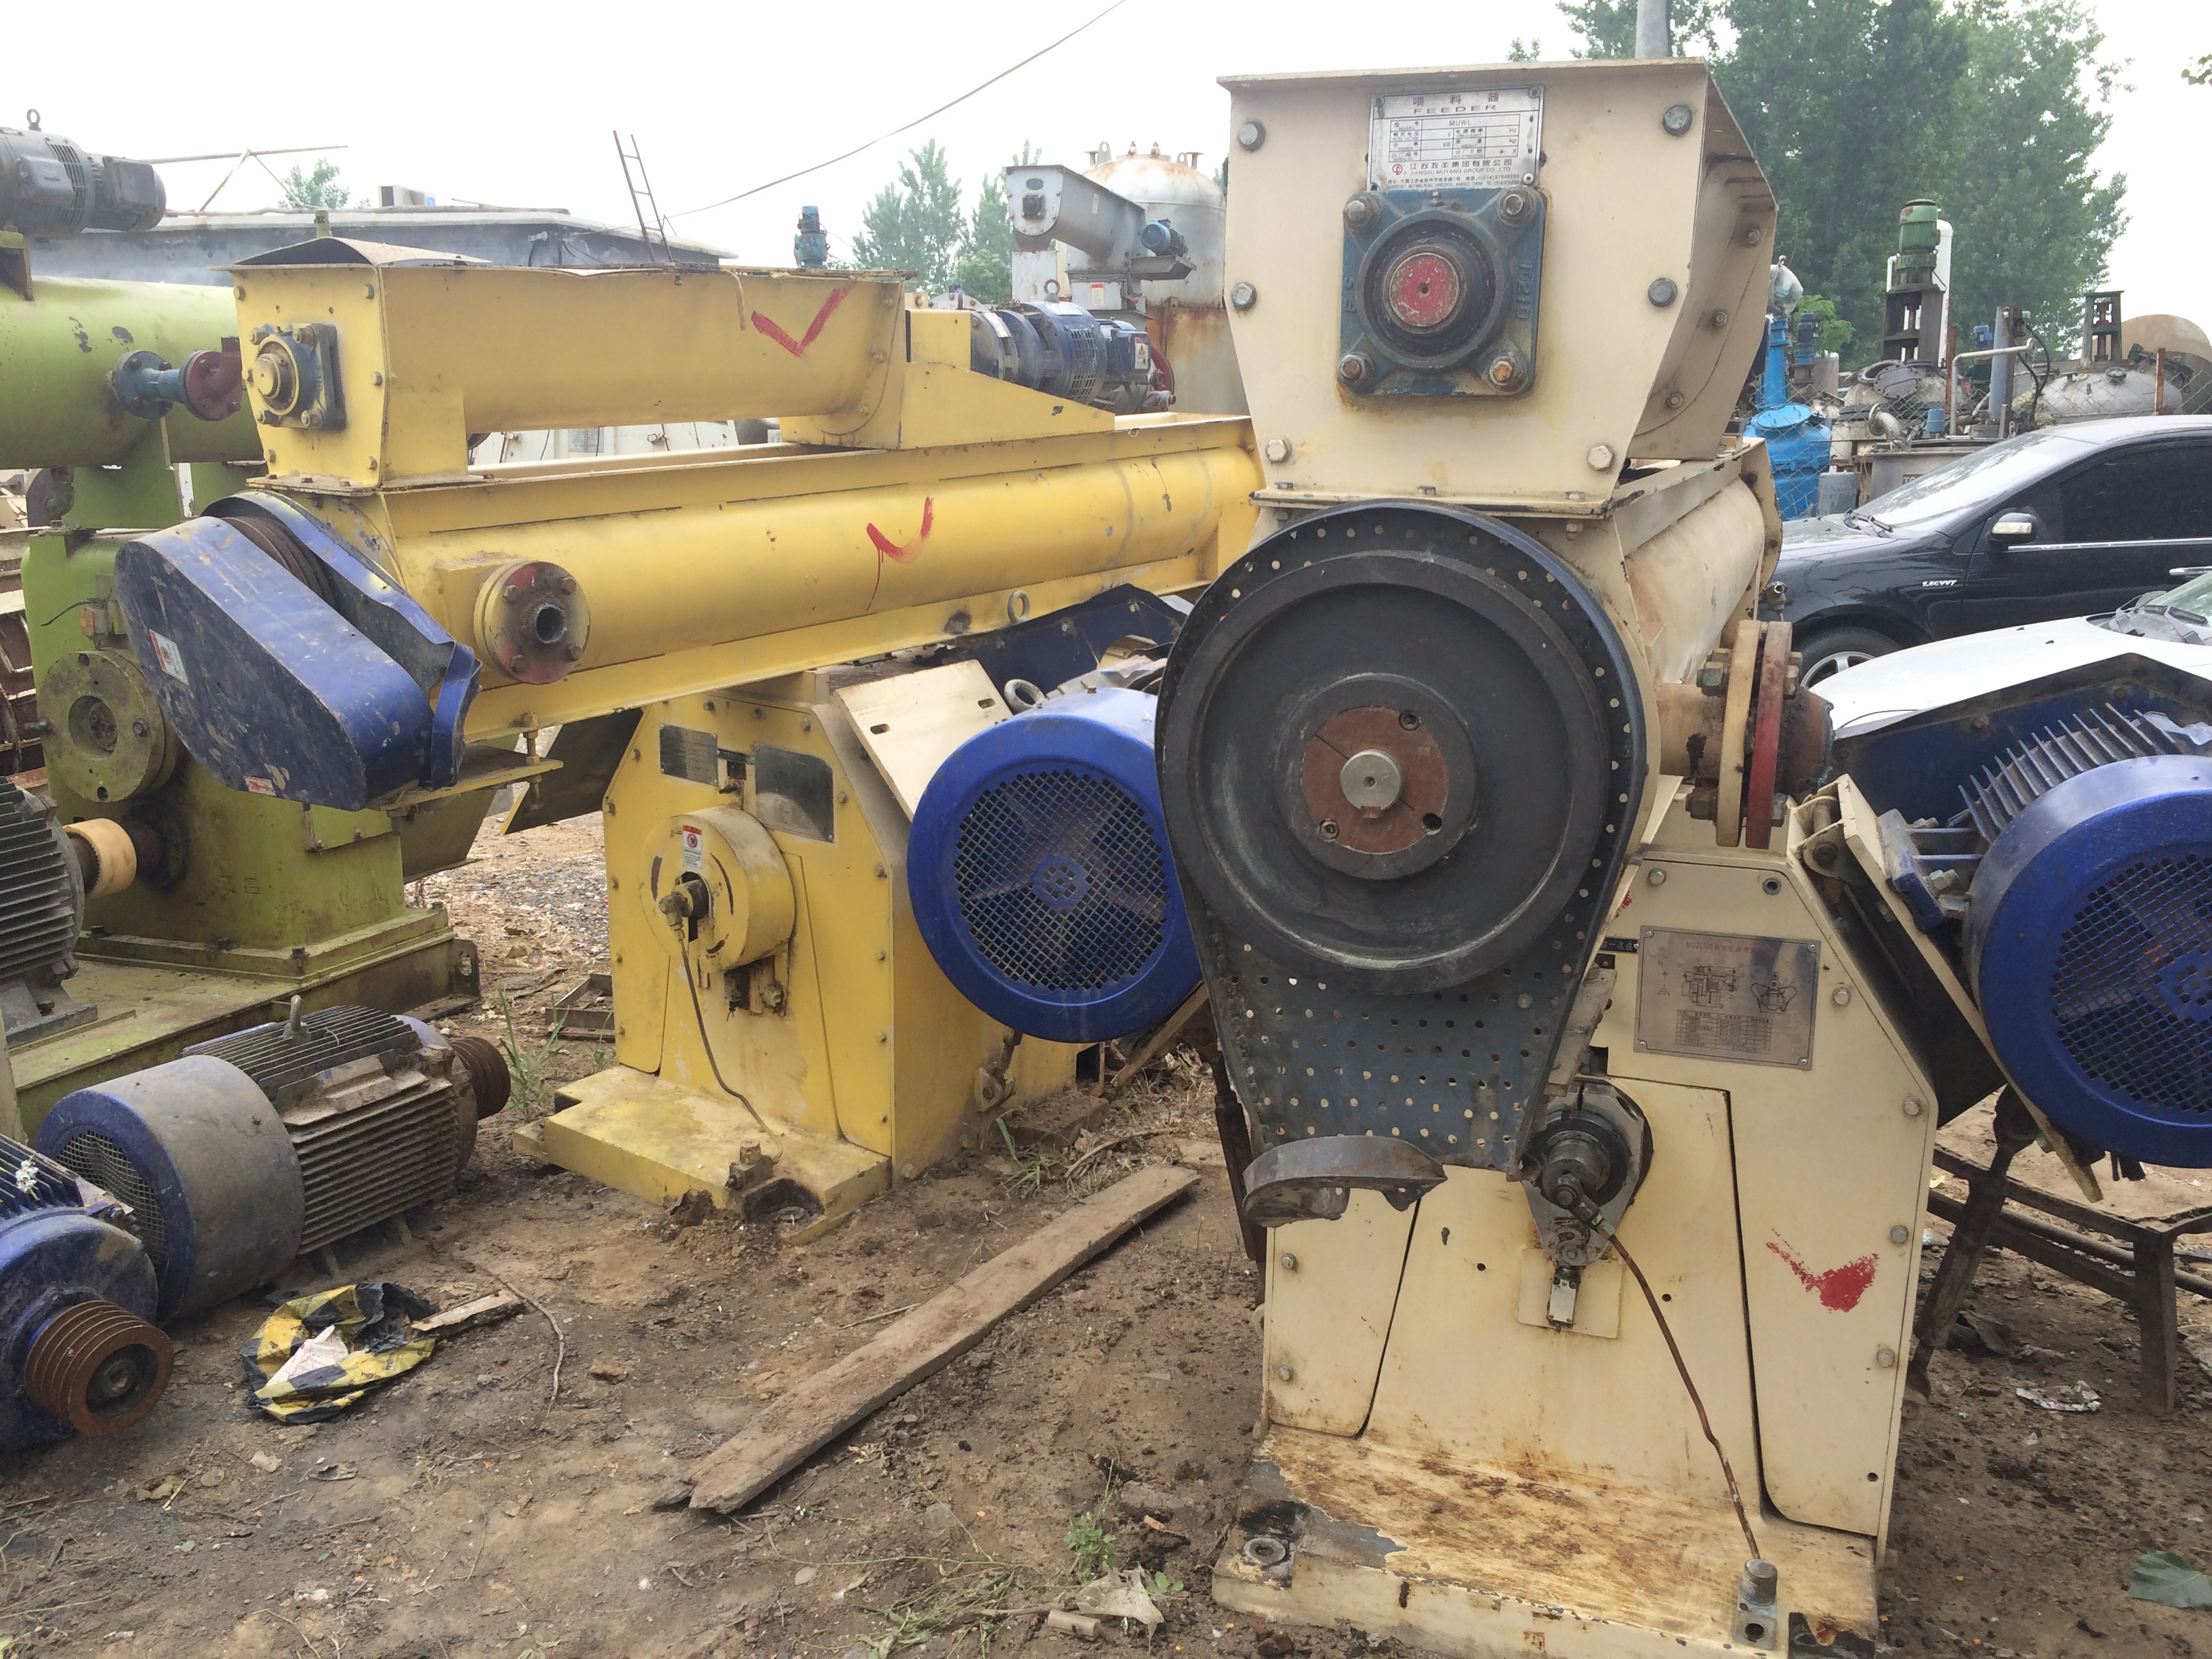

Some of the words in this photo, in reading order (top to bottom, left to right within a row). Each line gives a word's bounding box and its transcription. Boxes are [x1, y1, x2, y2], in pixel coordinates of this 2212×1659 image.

[1412, 92, 1500, 106] 喂料器
[1413, 105, 1497, 115] FEEDER
